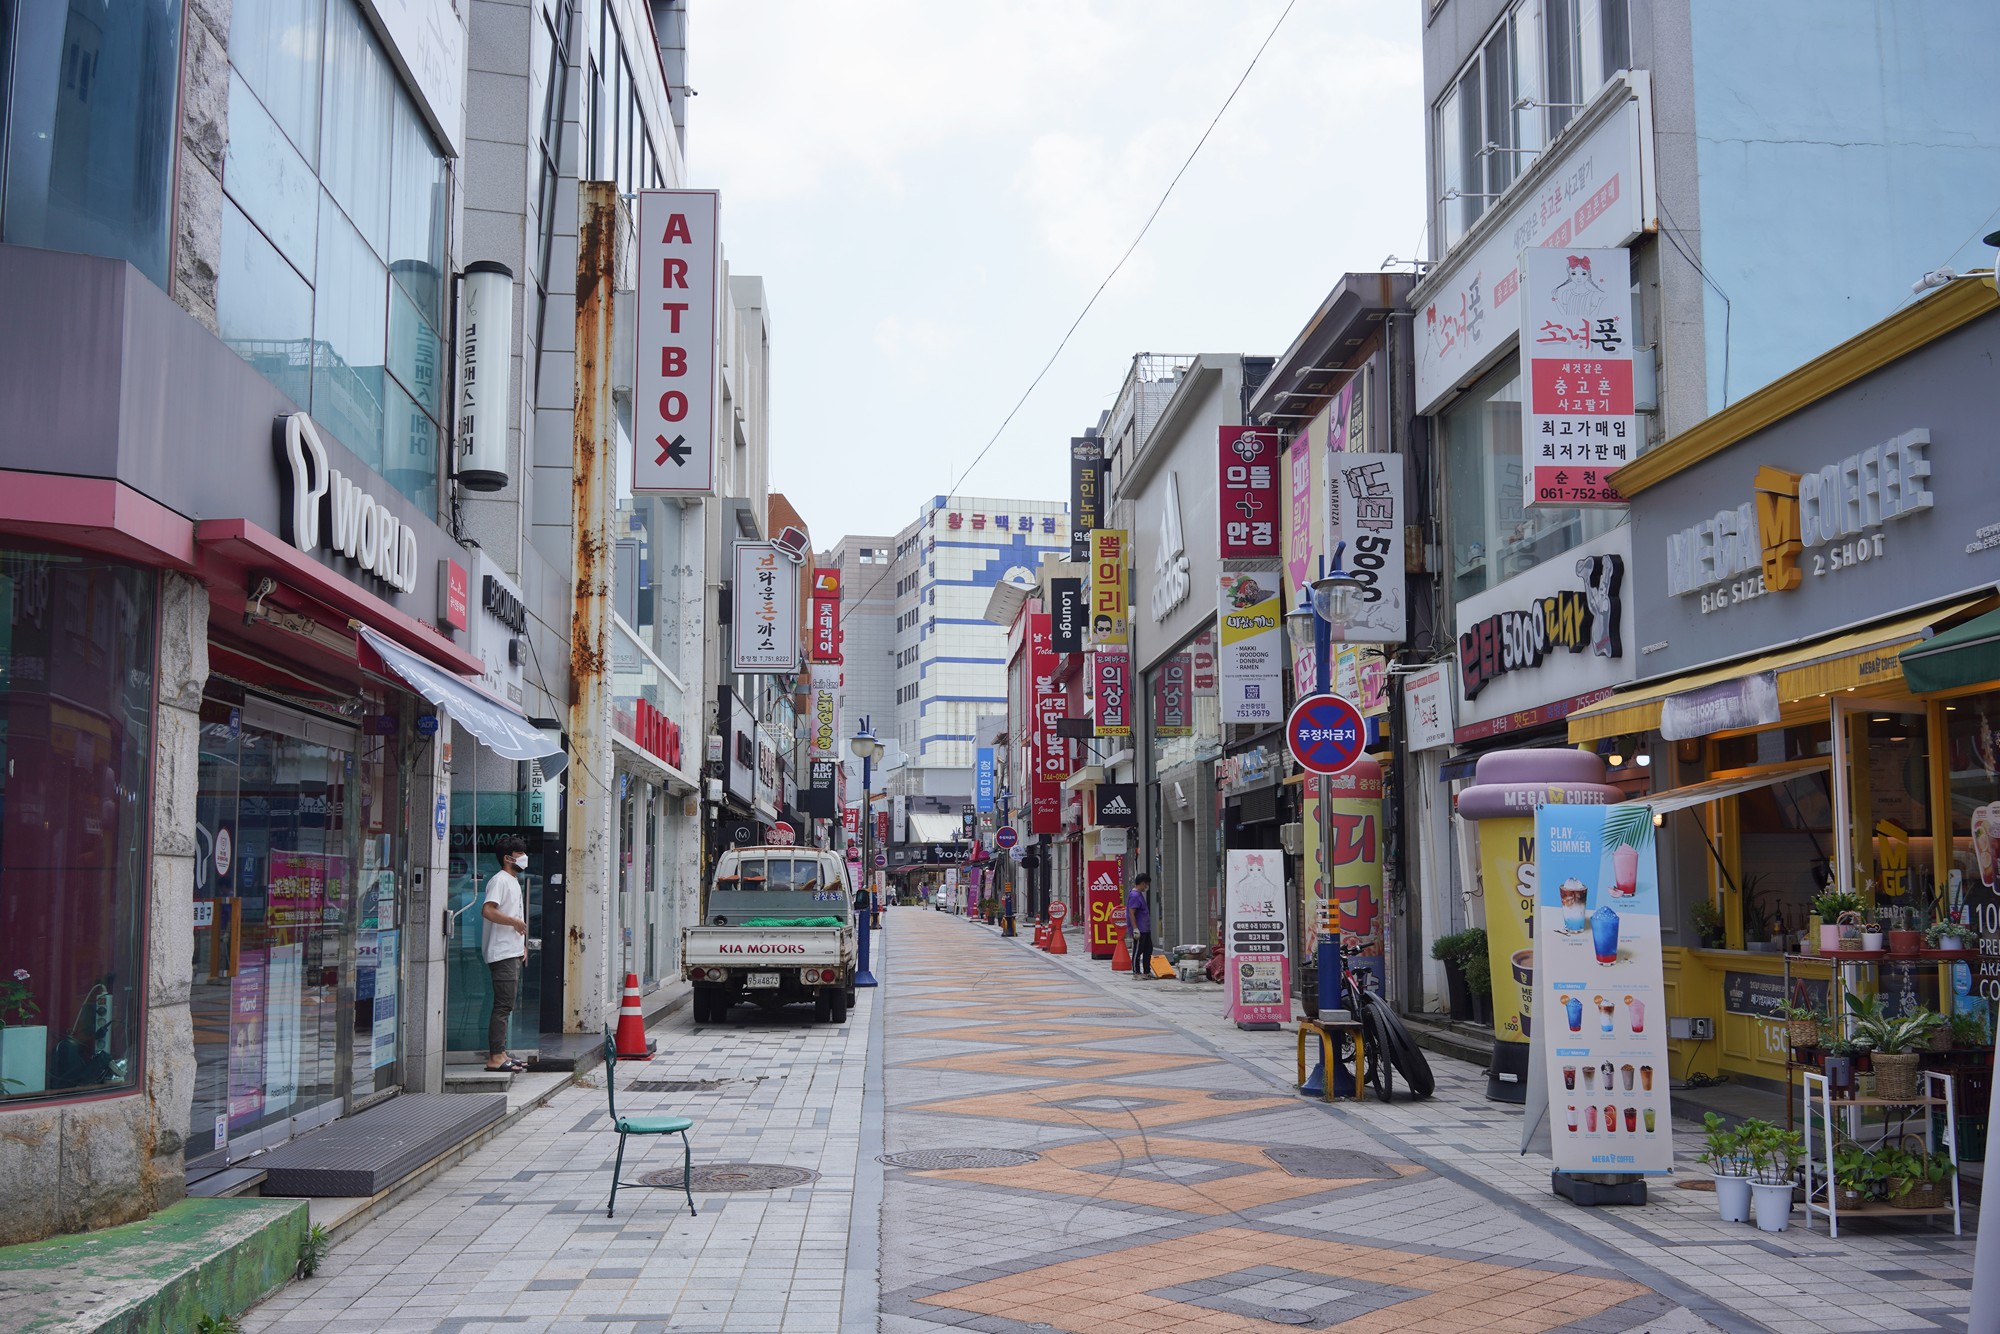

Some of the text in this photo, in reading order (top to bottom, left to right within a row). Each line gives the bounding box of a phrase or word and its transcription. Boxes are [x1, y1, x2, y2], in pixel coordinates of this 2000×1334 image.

[1561, 363, 1603, 374] 새것같은
[461, 323, 477, 455] 브로맨스 헤어
[1554, 378, 1611, 396] 중고폰
[1558, 399, 1609, 412] 사고팔기
[1542, 420, 1626, 437] 최고가매입
[1542, 443, 1626, 460] 최저가판매
[1080, 469, 1096, 528] 코인노래
[1330, 478, 1340, 526] NANTAPIZZA
[1666, 502, 1763, 598] MEGA
[1799, 427, 1934, 548] COFFEE
[329, 469, 418, 594] WORLD
[948, 512, 1056, 534] 황금백화점
[1227, 521, 1272, 546] 안경
[1813, 534, 1886, 576] 2 SHOT
[1099, 536, 1121, 613] 뽑의리
[755, 553, 779, 651] 브라운돈까스
[1701, 575, 1768, 614] BIG SIZE
[1059, 591, 1074, 640] Lounge
[819, 603, 834, 655] 롯데리아
[1501, 599, 1545, 671] 5000
[1543, 591, 1588, 652] 피자
[1039, 698, 1067, 710] 신전
[1101, 666, 1124, 726] 의상실
[1236, 709, 1270, 717] 751-9979
[1298, 729, 1356, 741] 주정차금지
[1492, 718, 1507, 734] 난타
[813, 763, 832, 772] ABC
[1504, 790, 1547, 806] MEGA
[1566, 790, 1605, 804] COFFEE
[1102, 806, 1132, 815] adidas
[1550, 827, 1573, 839] PLAY
[1550, 841, 1591, 853] SUMMER
[1094, 923, 1119, 945] LE
[719, 944, 805, 954] KIA MOTORS
[1591, 1155, 1635, 1163] MEGA COFFEE
